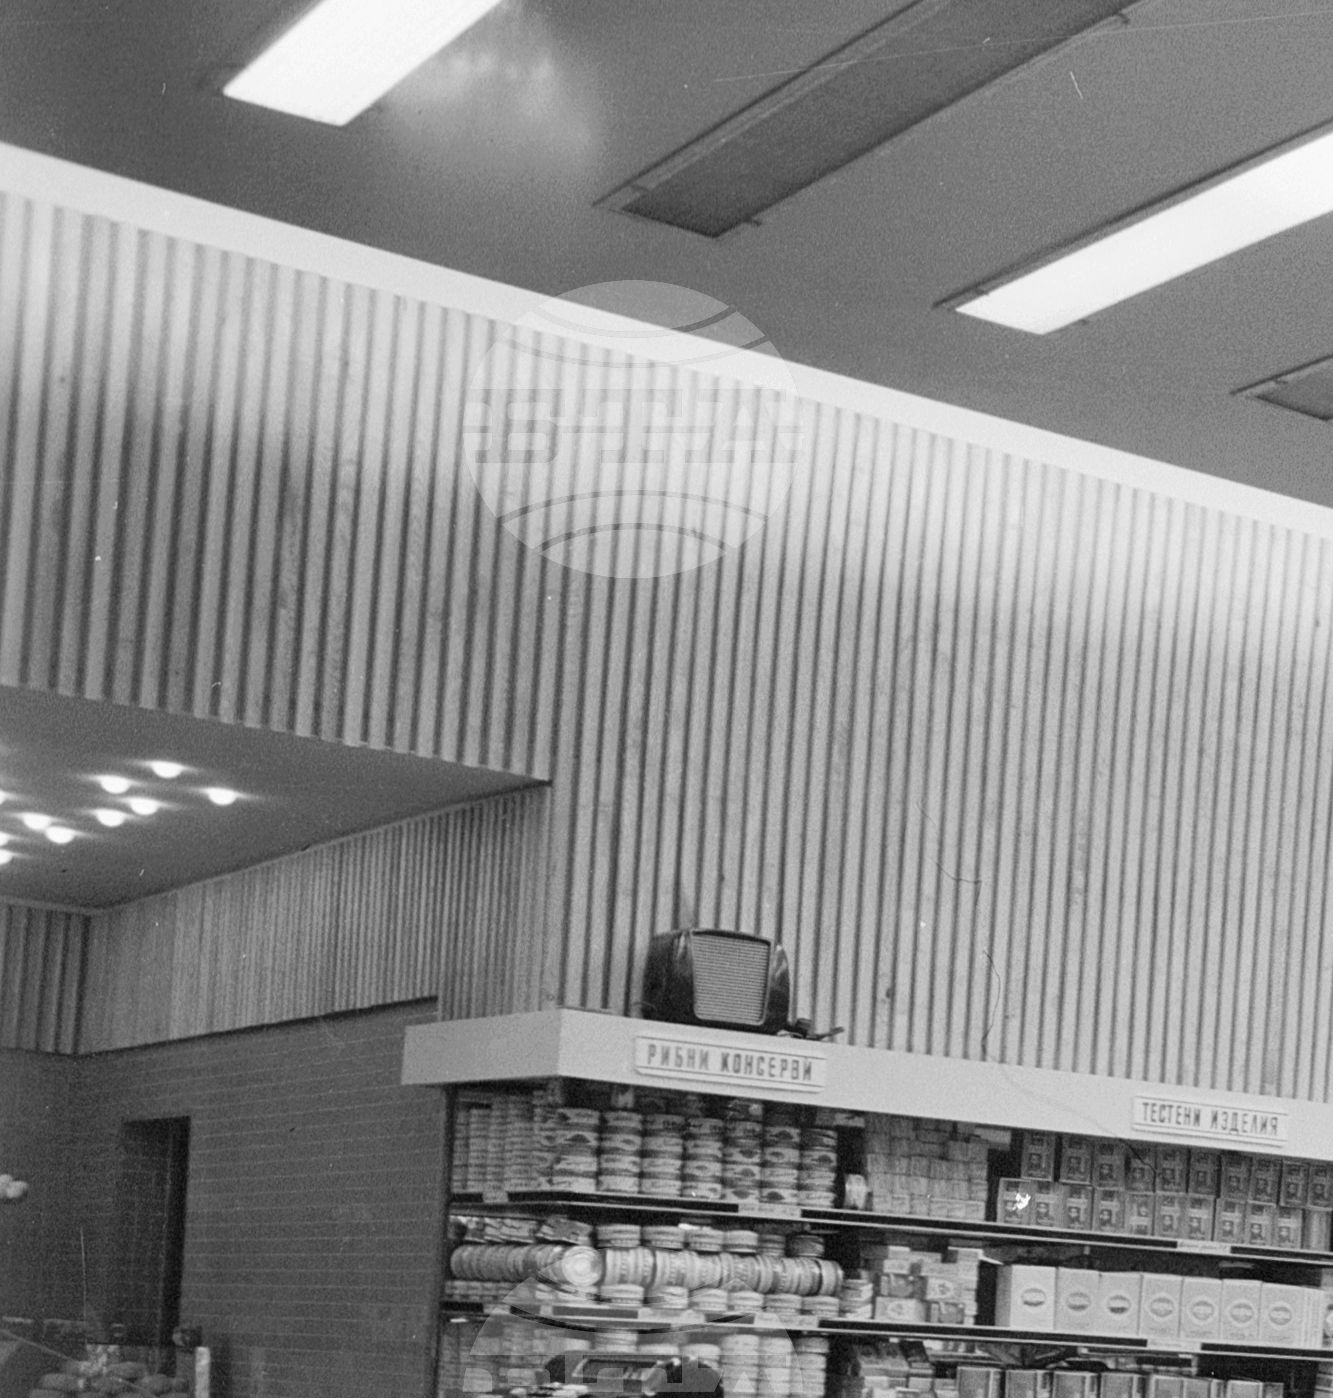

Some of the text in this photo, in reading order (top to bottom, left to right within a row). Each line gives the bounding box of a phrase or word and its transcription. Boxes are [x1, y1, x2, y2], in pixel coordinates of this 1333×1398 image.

[647, 1043, 812, 1081] РИБНИ КОНСЕРВИ
[1142, 1102, 1279, 1136] ТЕСТЕНИ ИЗДЕЛИЯ
